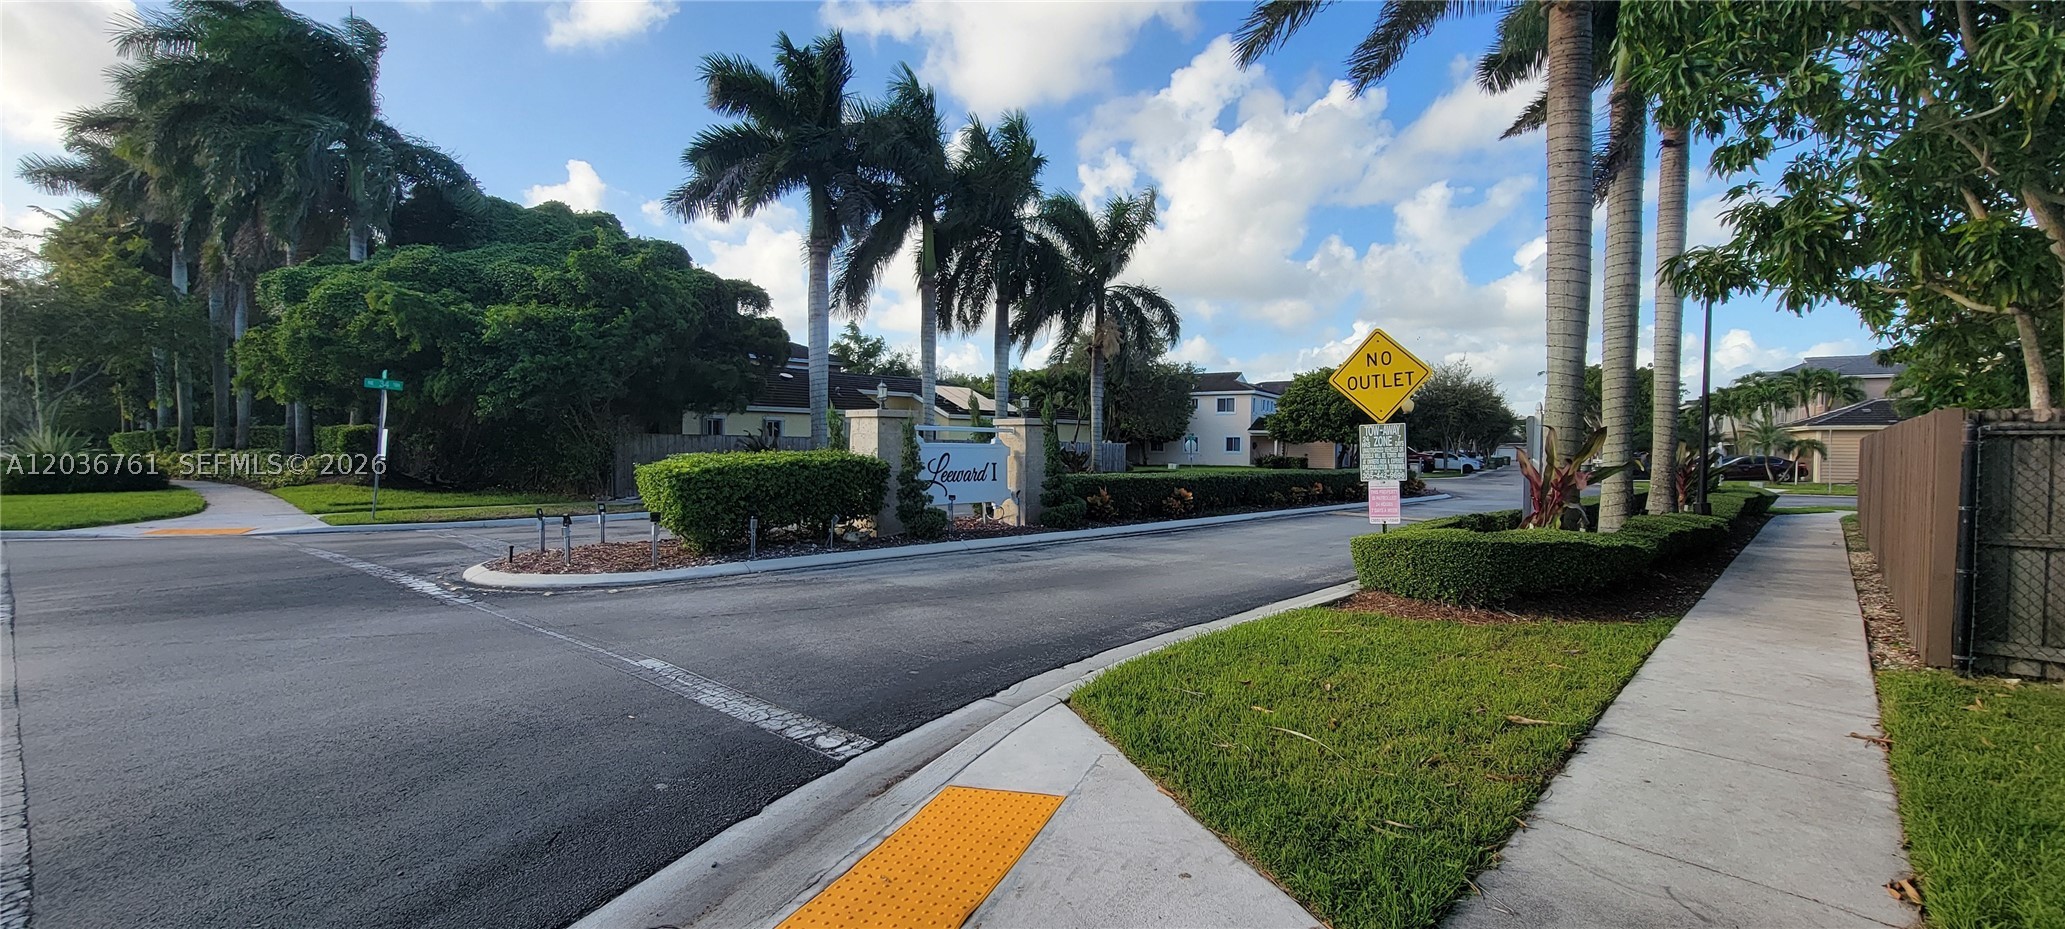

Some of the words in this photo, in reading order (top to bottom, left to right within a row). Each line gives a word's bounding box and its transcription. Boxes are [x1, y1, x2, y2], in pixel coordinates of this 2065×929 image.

[1366, 351, 1392, 367] NO
[1347, 371, 1415, 391] OUTLET
[1364, 424, 1401, 436] TOW-AWAY
[1373, 435, 1393, 447] ZONE
[921, 452, 990, 497] Leeward
